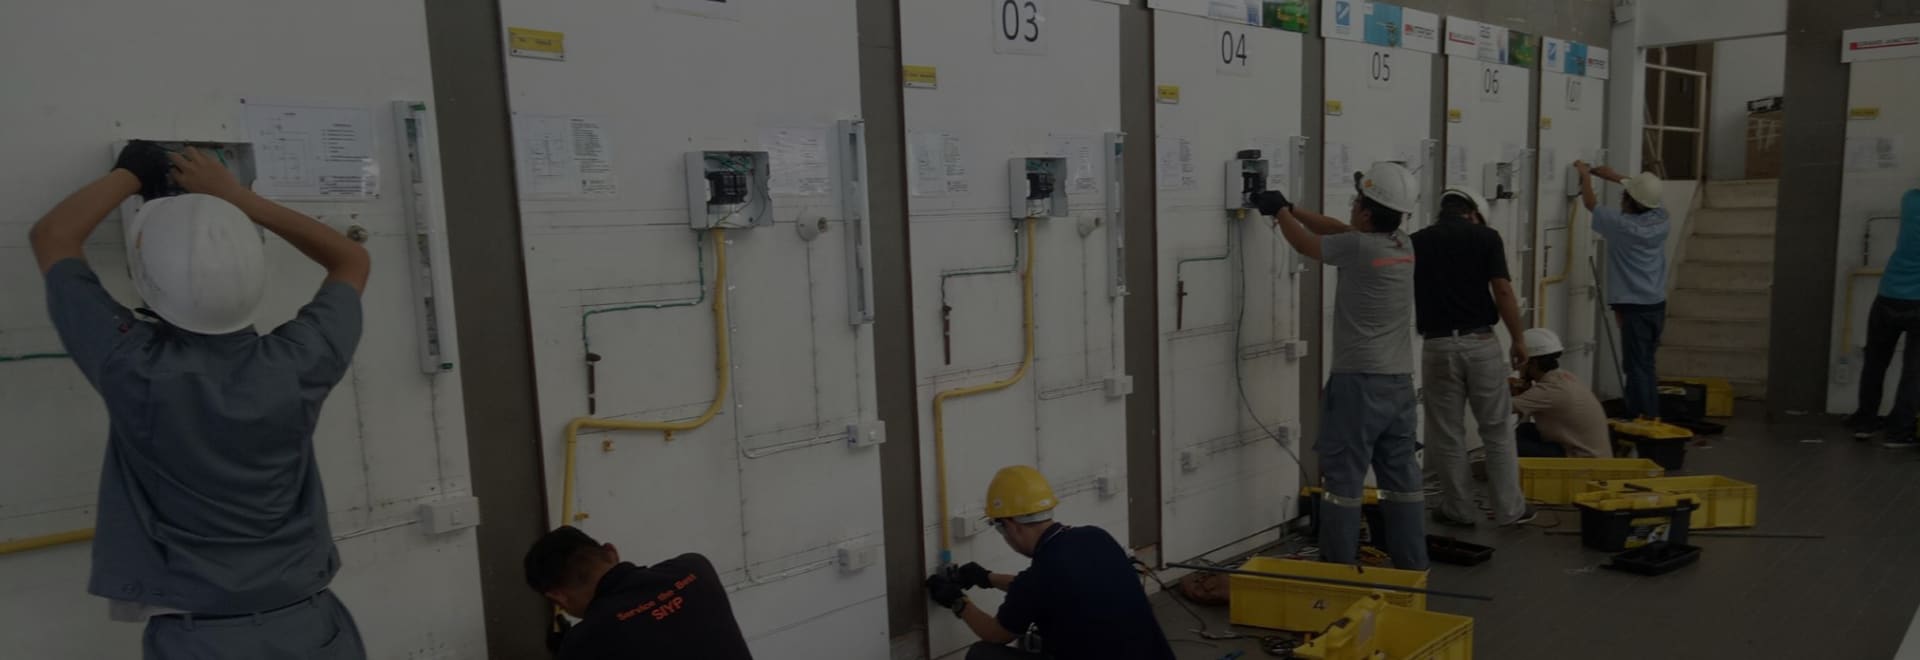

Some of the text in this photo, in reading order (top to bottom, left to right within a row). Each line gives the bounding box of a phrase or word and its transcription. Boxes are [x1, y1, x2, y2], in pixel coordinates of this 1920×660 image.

[1002, 0, 1039, 42] 03
[1221, 30, 1248, 66] 04
[1371, 51, 1391, 82] 05
[1484, 67, 1500, 94] 06
[1312, 599, 1325, 610] 4
